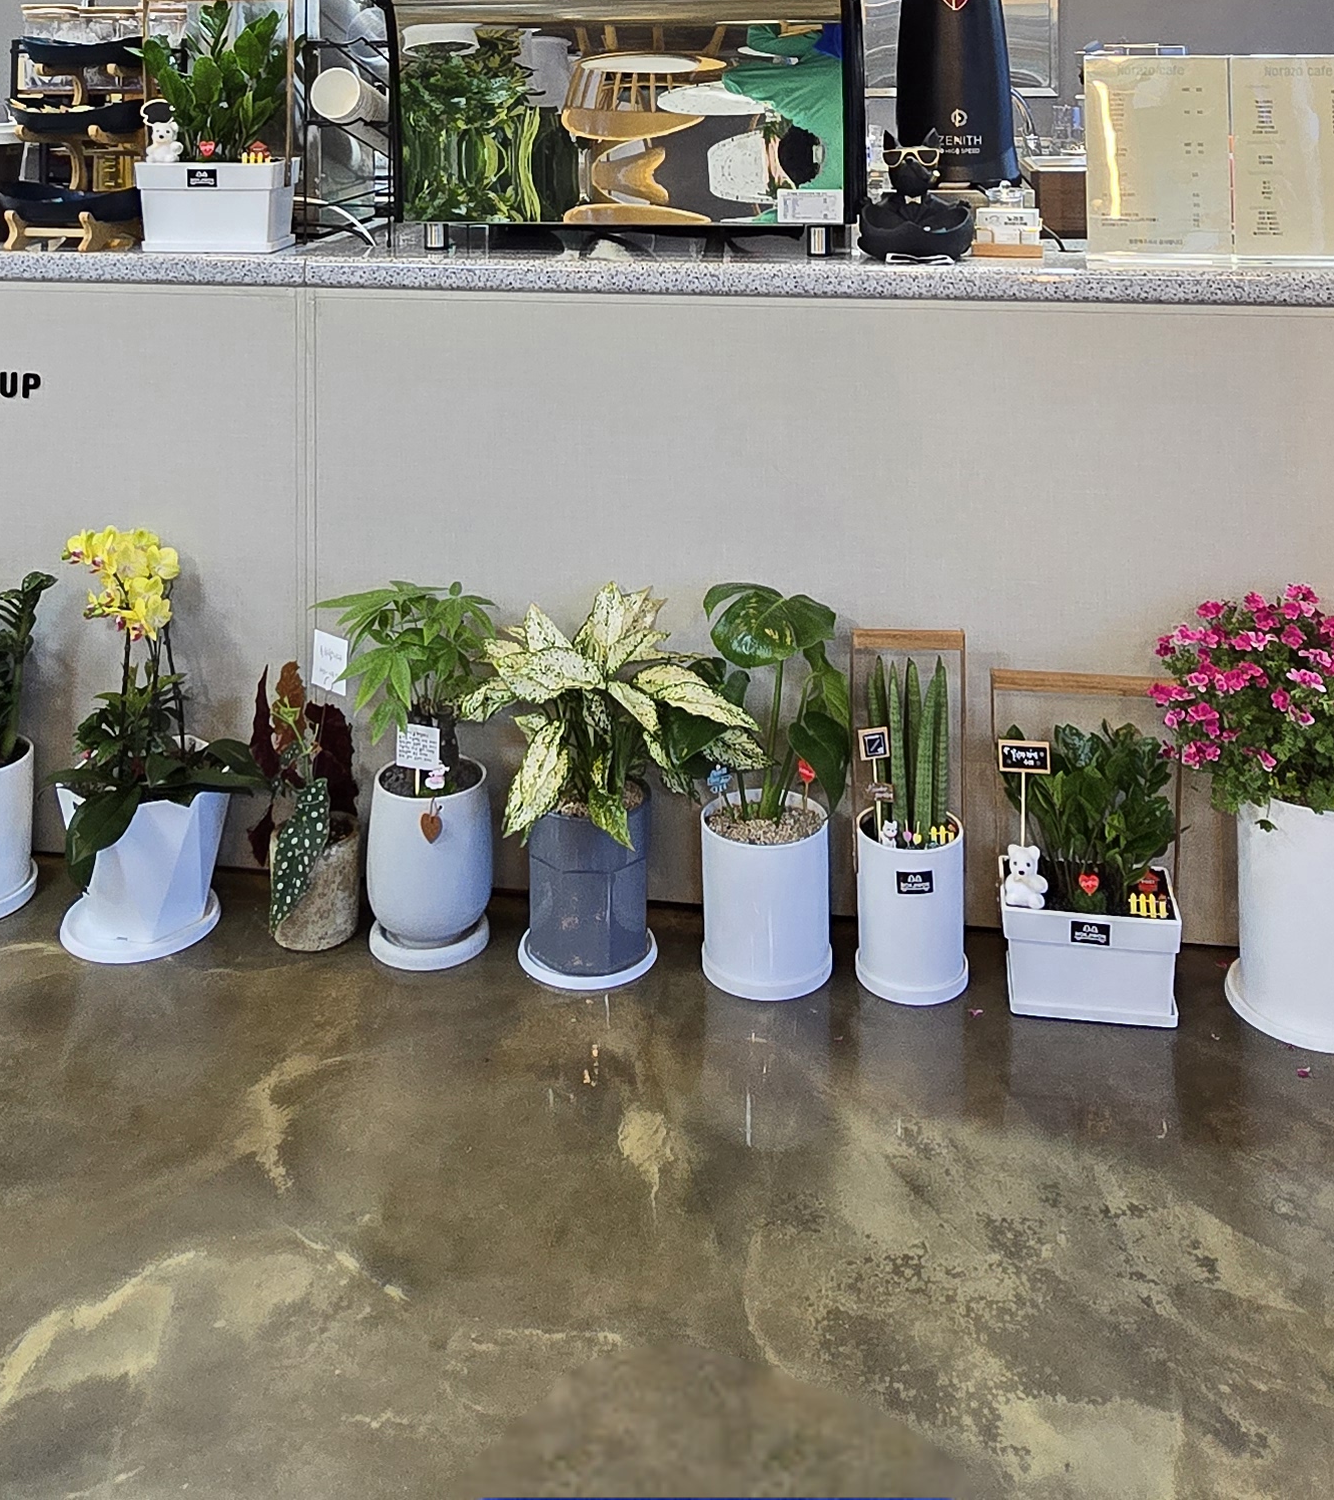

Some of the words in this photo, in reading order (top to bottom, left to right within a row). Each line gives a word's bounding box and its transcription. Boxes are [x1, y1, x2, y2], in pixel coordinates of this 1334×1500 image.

[1307, 65, 1333, 77] cafe
[938, 135, 983, 146] ZENITH
[0, 371, 43, 399] UP
